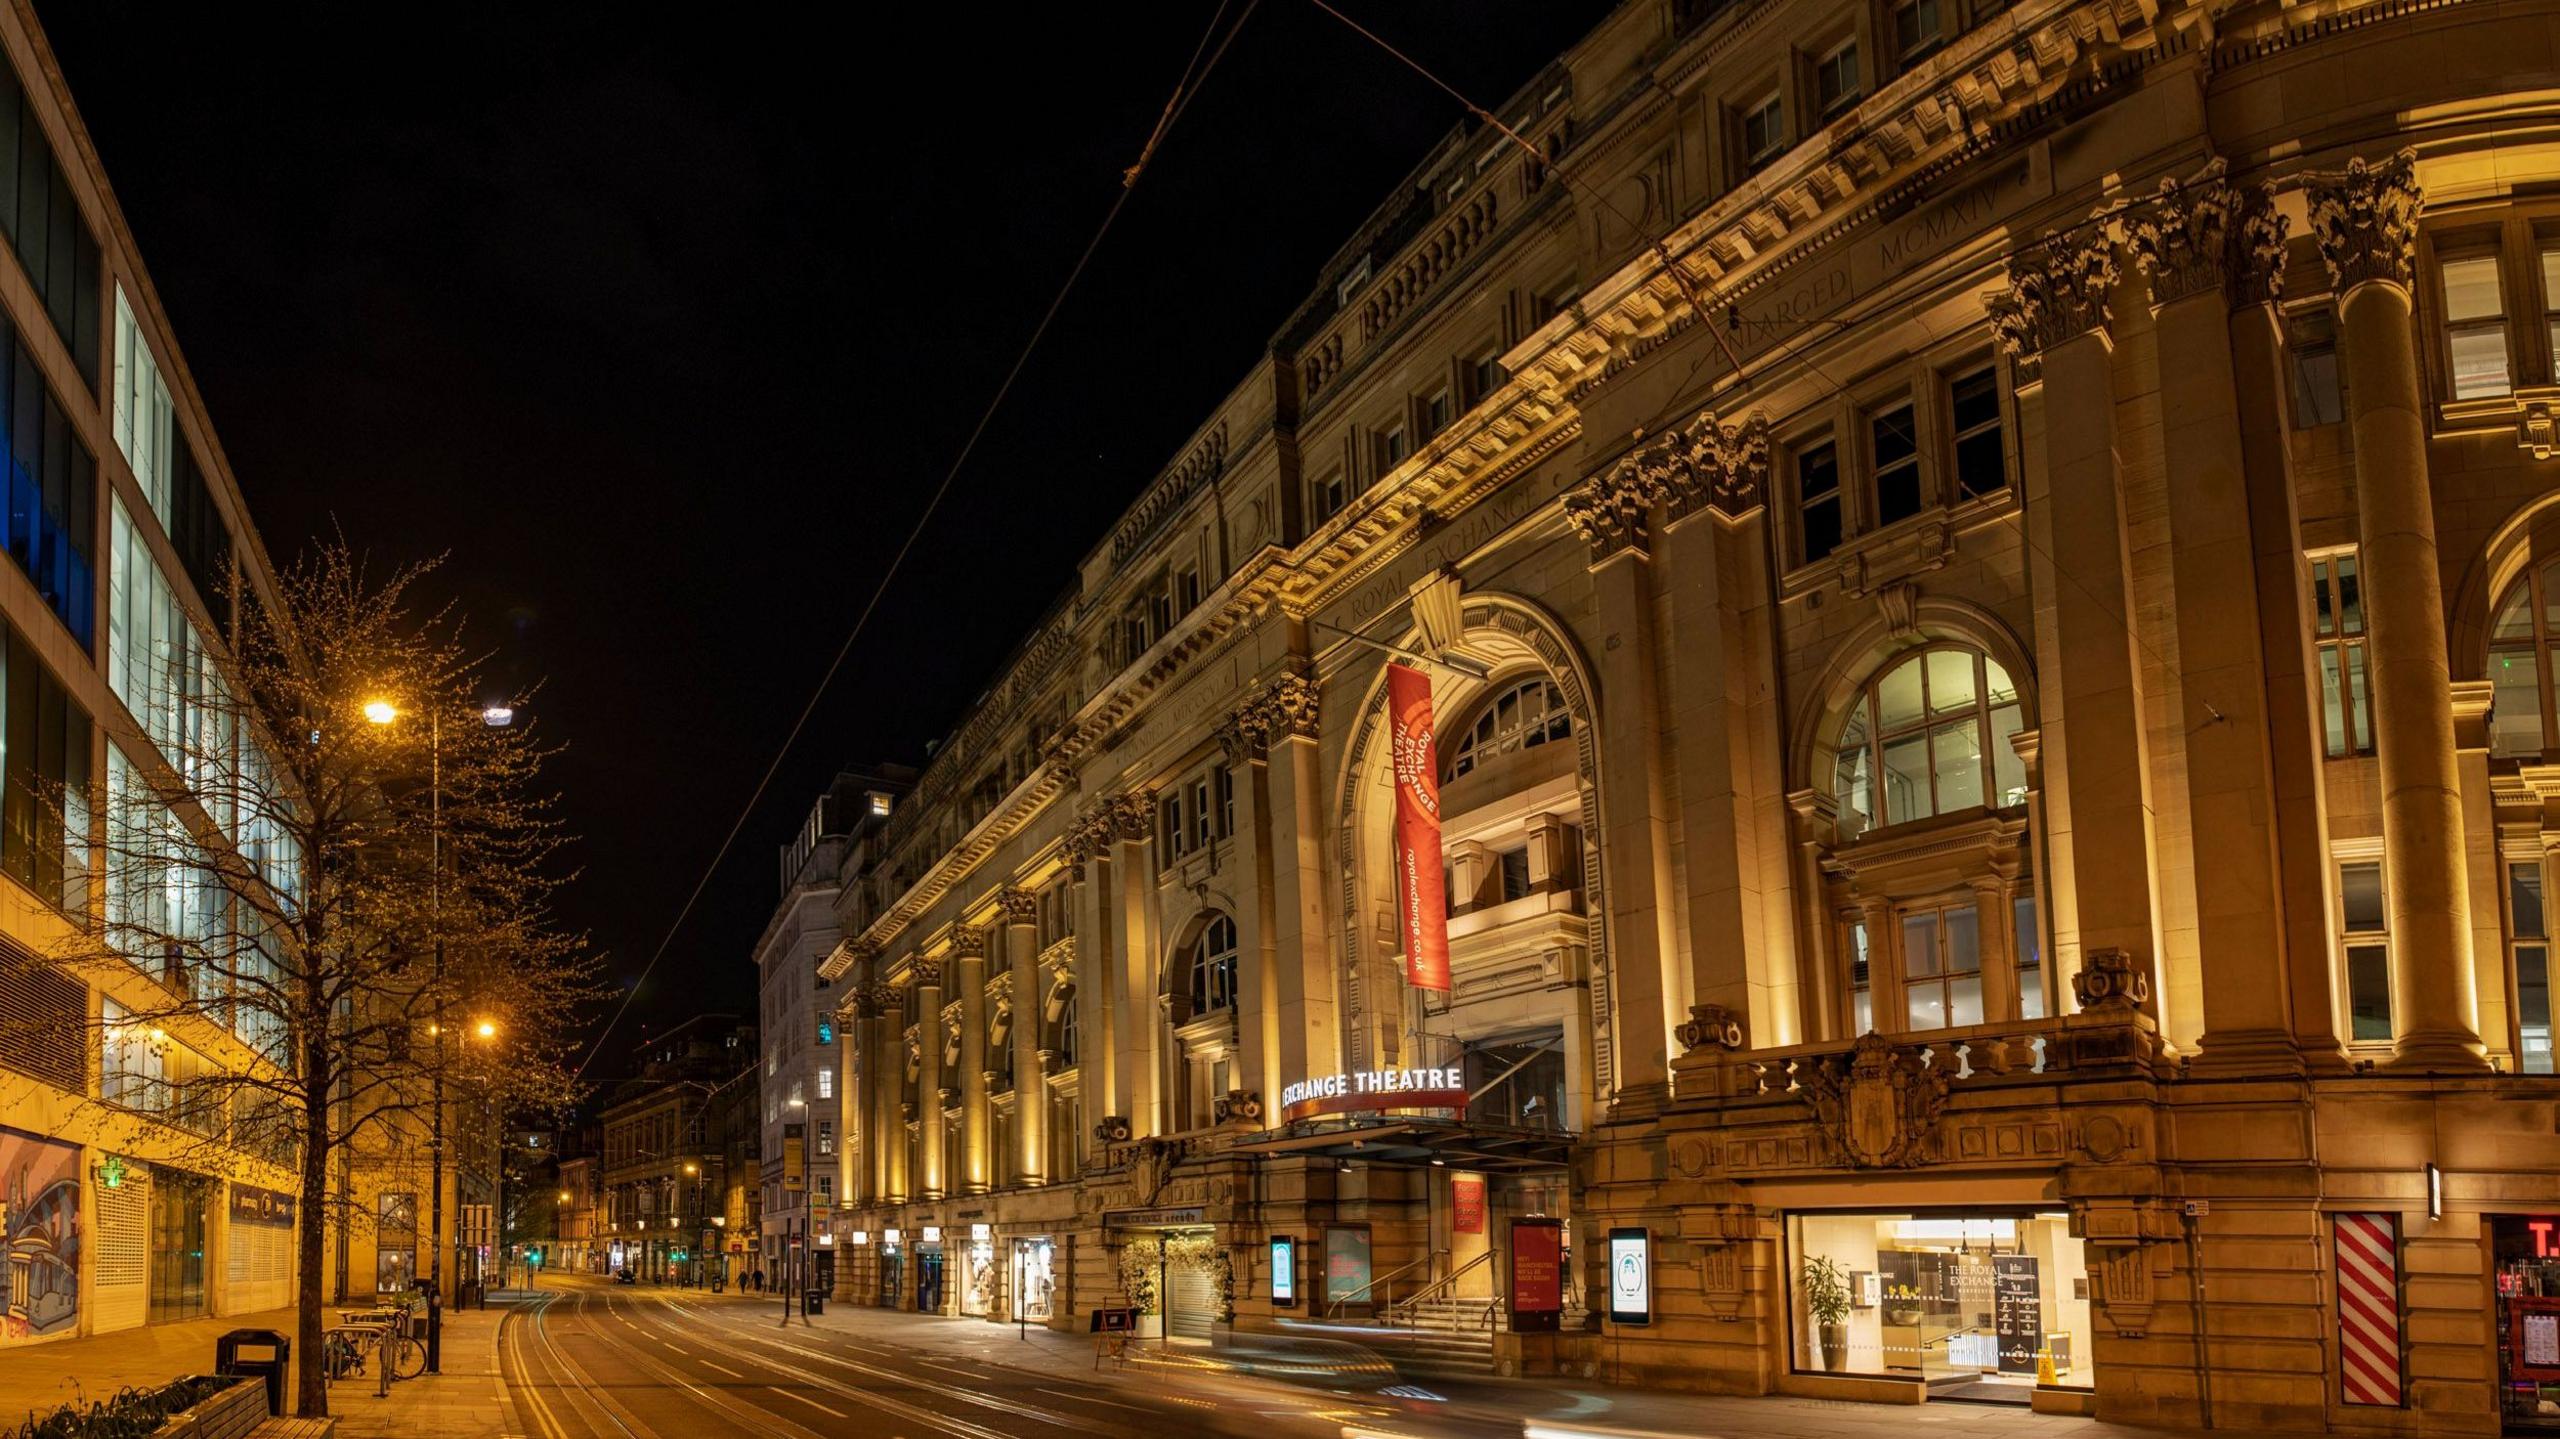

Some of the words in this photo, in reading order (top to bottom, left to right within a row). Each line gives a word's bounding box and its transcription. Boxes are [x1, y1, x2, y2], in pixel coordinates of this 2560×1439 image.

[1423, 482, 1537, 573] EXCHANGE
[1393, 722, 1410, 784] THEATRE
[1416, 730, 1432, 774] ROYAL
[1405, 736, 1436, 813] EXCHANGE
[1408, 848, 1425, 972] royalexchange.co.uk
[1284, 1073, 1348, 1106] EXCHANGE
[1354, 1068, 1462, 1092] THEATRE
[2528, 1222, 2560, 1257] T.
[1949, 1265, 1968, 1275] THE
[1970, 1265, 2002, 1275] ROYAL
[1949, 1276, 2004, 1287] EXCHANGE
